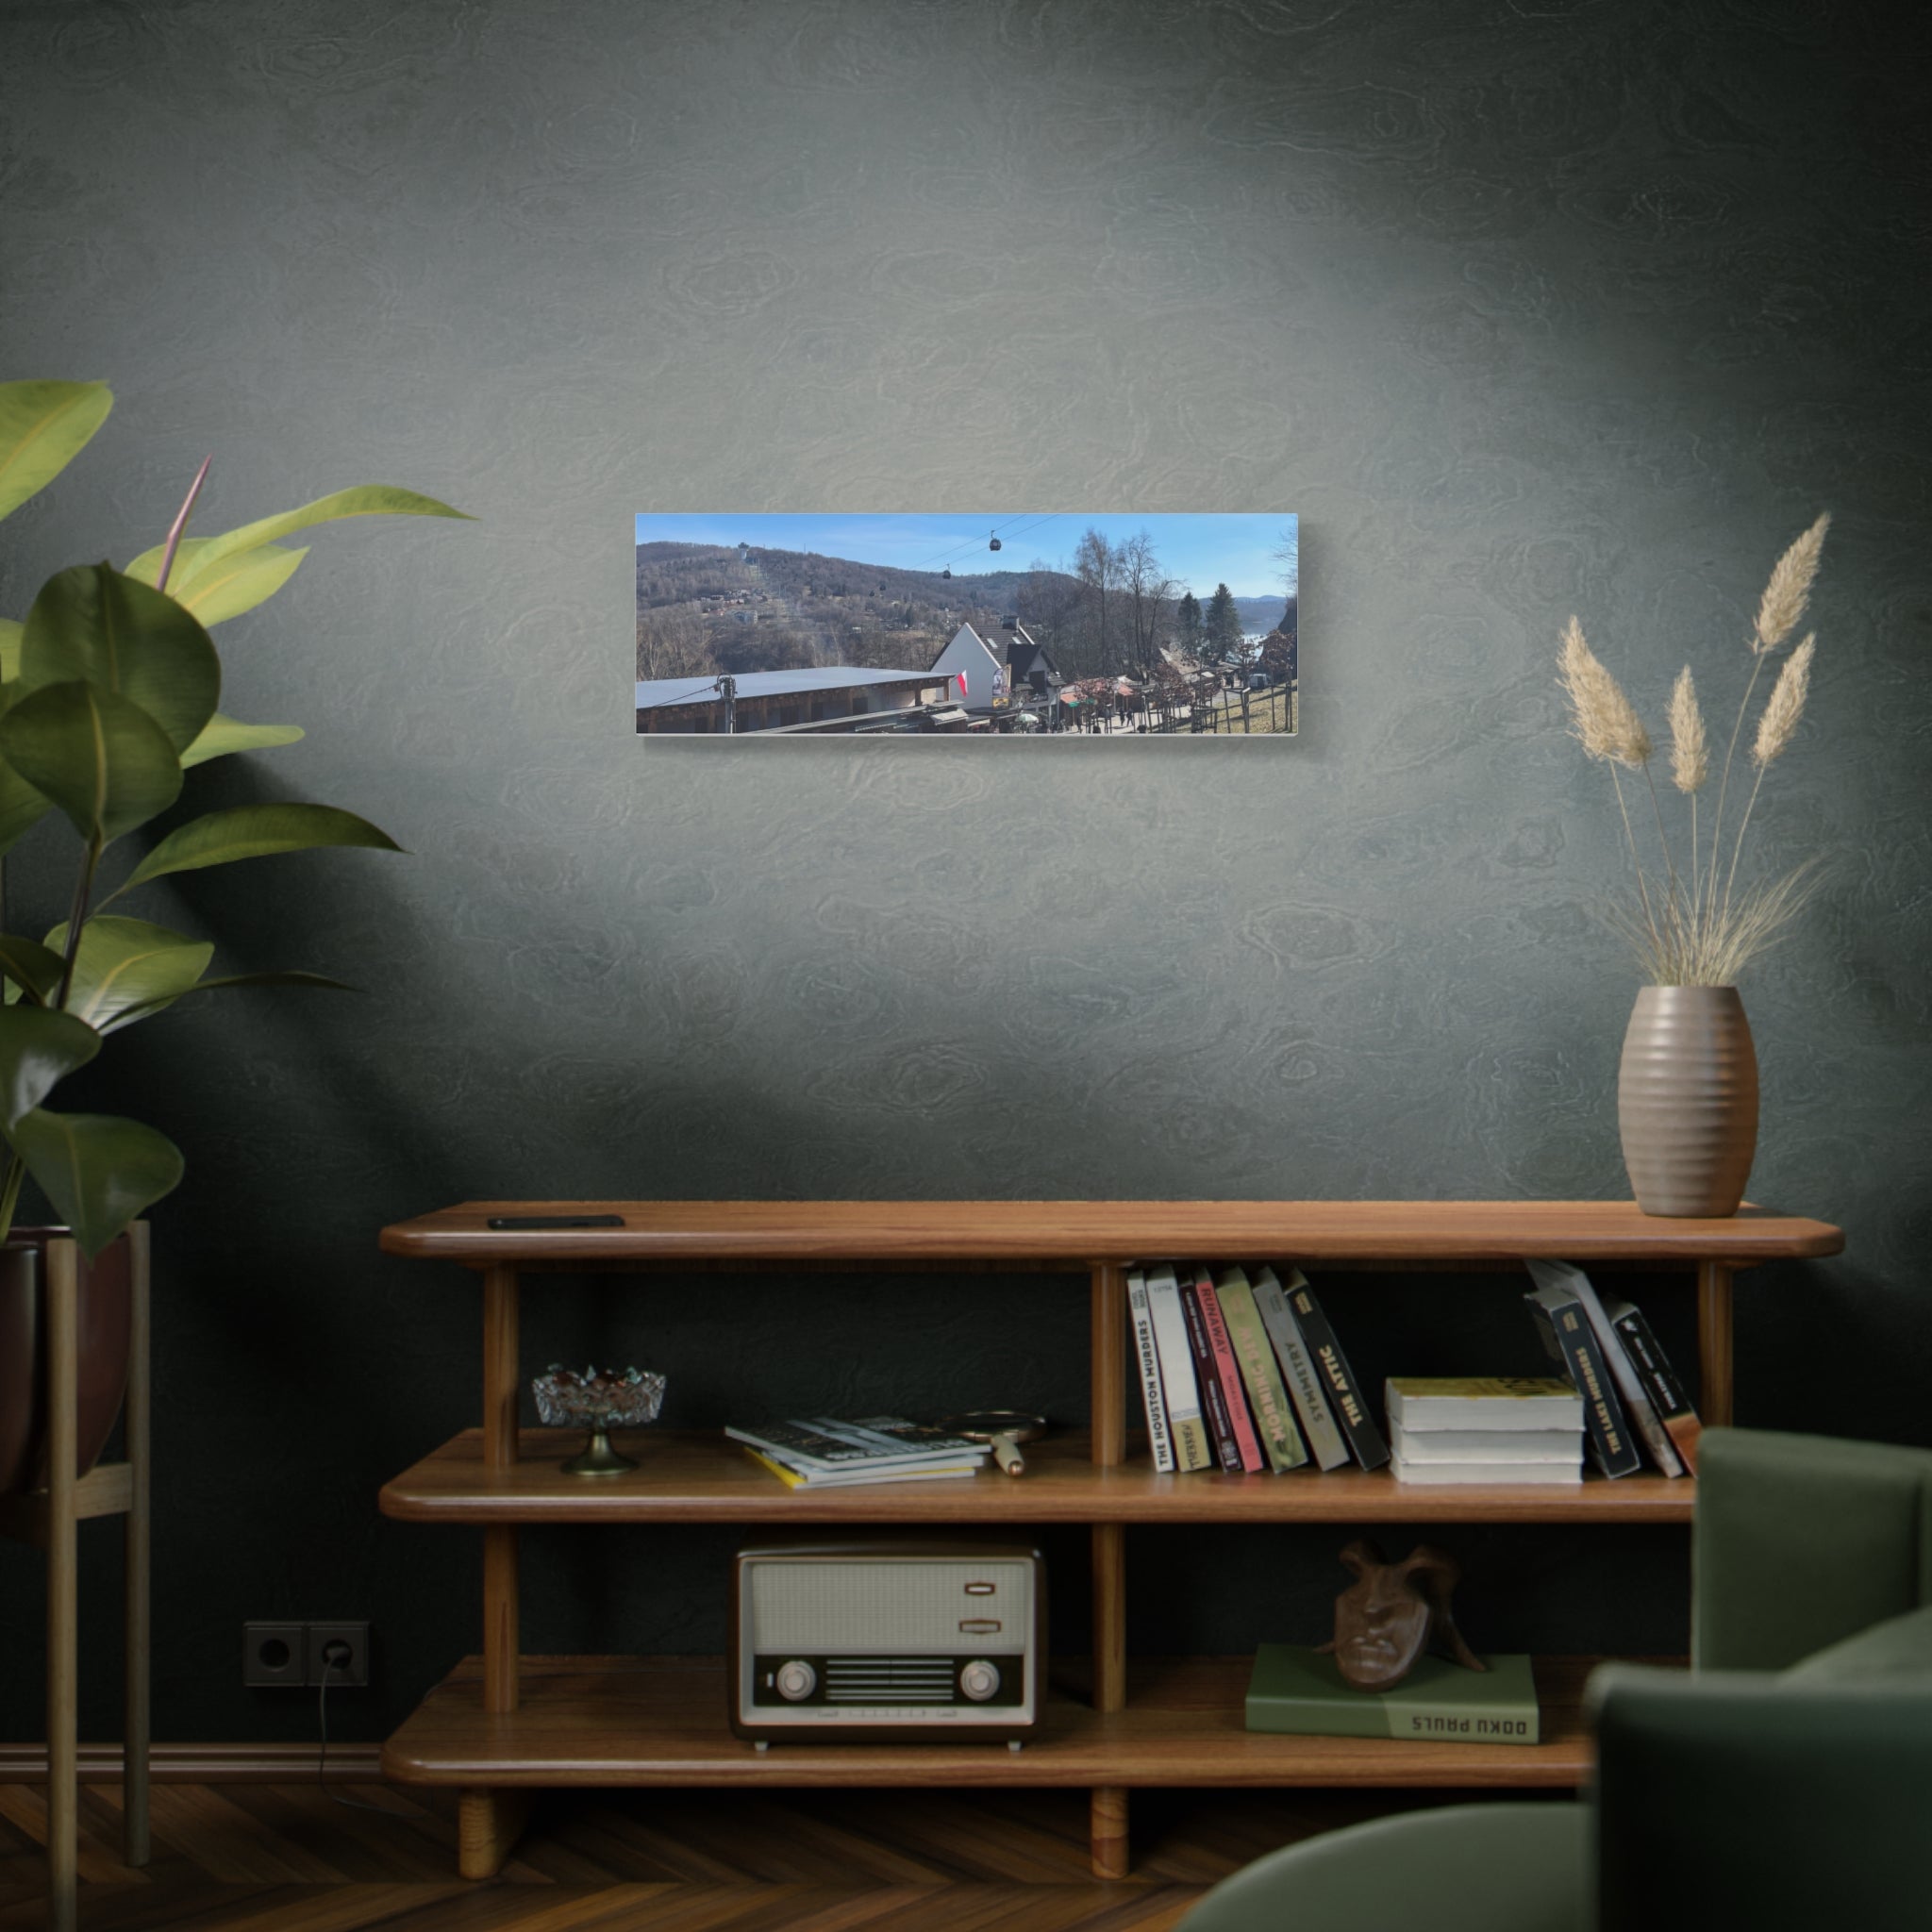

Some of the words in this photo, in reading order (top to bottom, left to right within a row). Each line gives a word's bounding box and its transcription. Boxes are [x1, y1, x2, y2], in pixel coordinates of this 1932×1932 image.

[1201, 1288, 1228, 1355] RUNAWAY
[1239, 1327, 1259, 1360] DEW
[1138, 1320, 1155, 1376] MURDERS
[1319, 1344, 1348, 1391] ATTIC
[1285, 1341, 1324, 1423] SYMMETRY
[1575, 1347, 1603, 1401] MURDERS
[1147, 1381, 1163, 1440] HOUSTON
[1251, 1363, 1286, 1441] MORNING
[1341, 1393, 1362, 1427] THE
[1595, 1401, 1613, 1431] LAKE
[1157, 1442, 1169, 1466] THE
[1606, 1430, 1622, 1455] THE
[1412, 1716, 1470, 1733] PAULS
